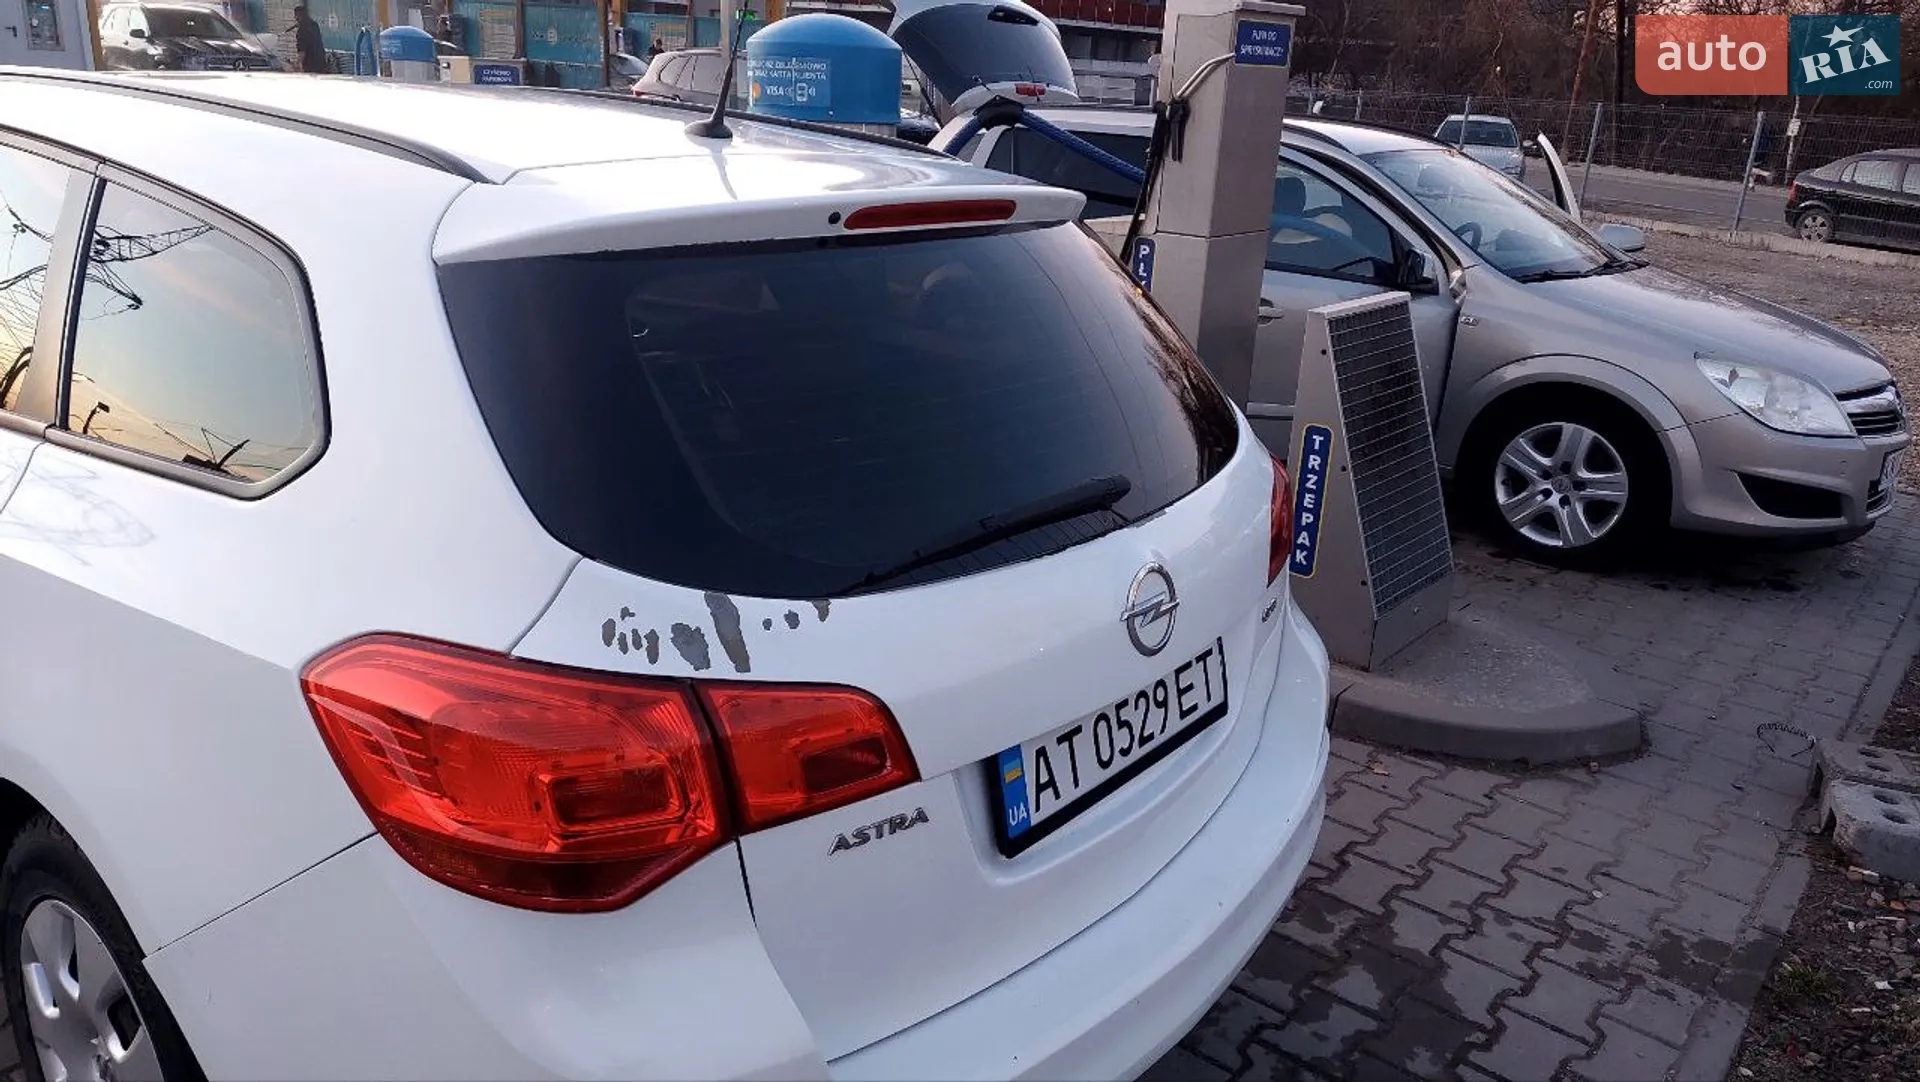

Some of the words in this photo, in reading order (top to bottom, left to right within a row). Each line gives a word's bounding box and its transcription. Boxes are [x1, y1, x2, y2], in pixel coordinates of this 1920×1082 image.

[765, 84, 785, 96] VISA
[1294, 434, 1325, 566] TRZEPAK
[1034, 724, 1083, 814] AT
[1093, 678, 1169, 770] 0529
[1174, 647, 1214, 721] ET
[827, 806, 930, 857] ASTRA
[1008, 802, 1028, 827] UA
